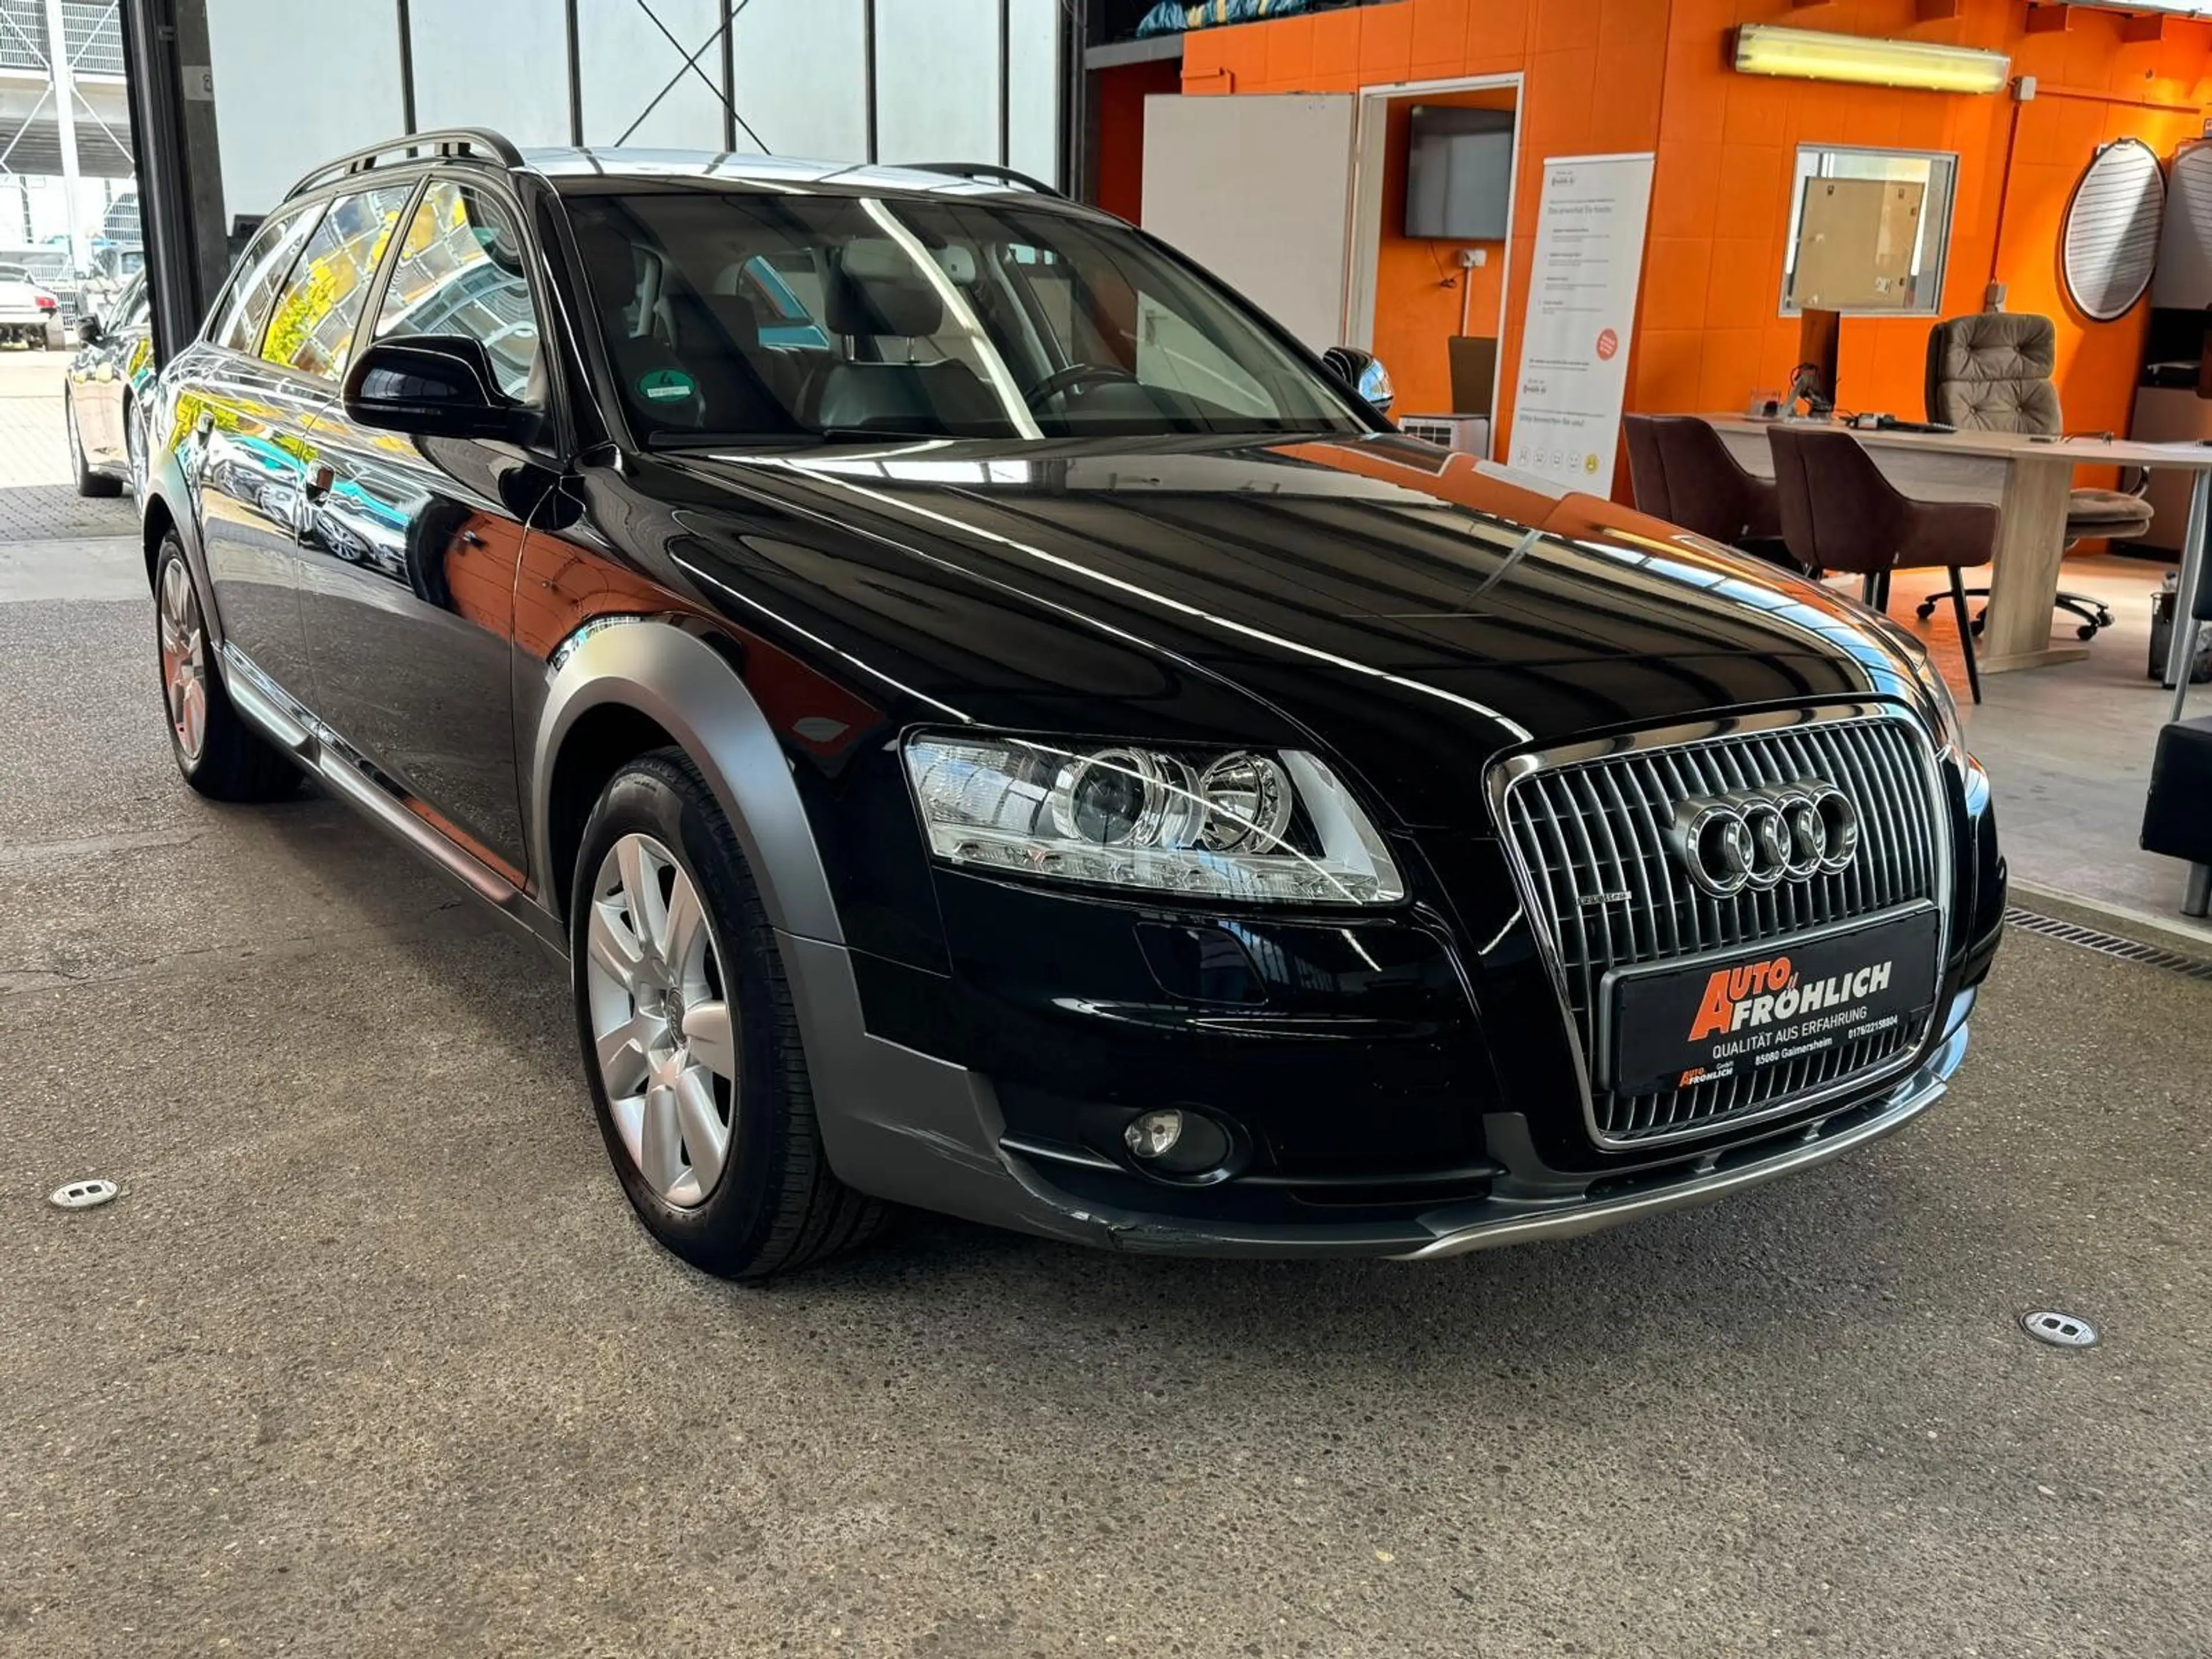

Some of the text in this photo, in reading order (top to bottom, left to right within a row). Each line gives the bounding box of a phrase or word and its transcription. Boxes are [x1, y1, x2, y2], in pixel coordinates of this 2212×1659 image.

[659, 372, 674, 385] 4
[1688, 956, 1791, 1041] AUTO
[1732, 961, 1892, 1031] FRÖHLICH
[1713, 1006, 1868, 1059] QUALITÄT AUS ERFAHRUNG
[1781, 1037, 1833, 1059] Gaimersheim
